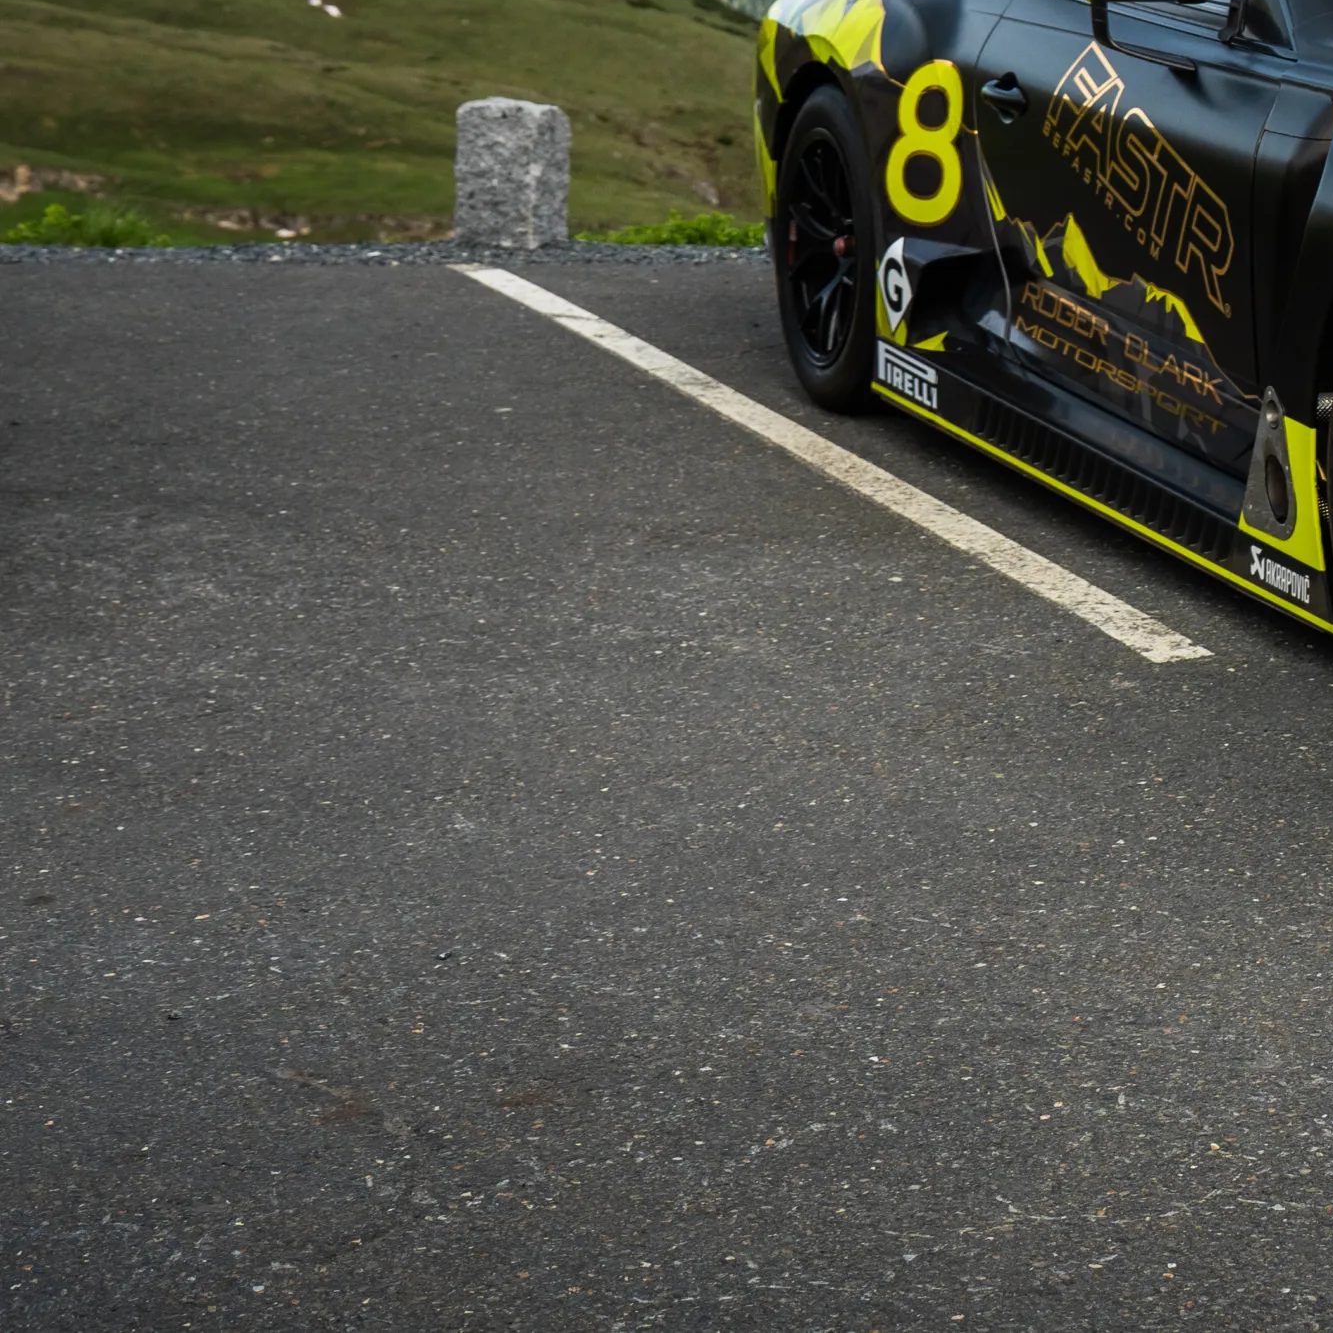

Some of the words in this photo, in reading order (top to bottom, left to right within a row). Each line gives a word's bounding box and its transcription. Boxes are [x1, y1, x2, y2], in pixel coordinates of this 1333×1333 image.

[885, 58, 965, 228] 8
[1041, 118, 1162, 262] BEFASTR.COM
[876, 339, 939, 409] PIRELLI
[1014, 315, 1229, 435] MOTORSPORT
[1020, 280, 1110, 346] ROGER
[1123, 331, 1224, 406] CLARK
